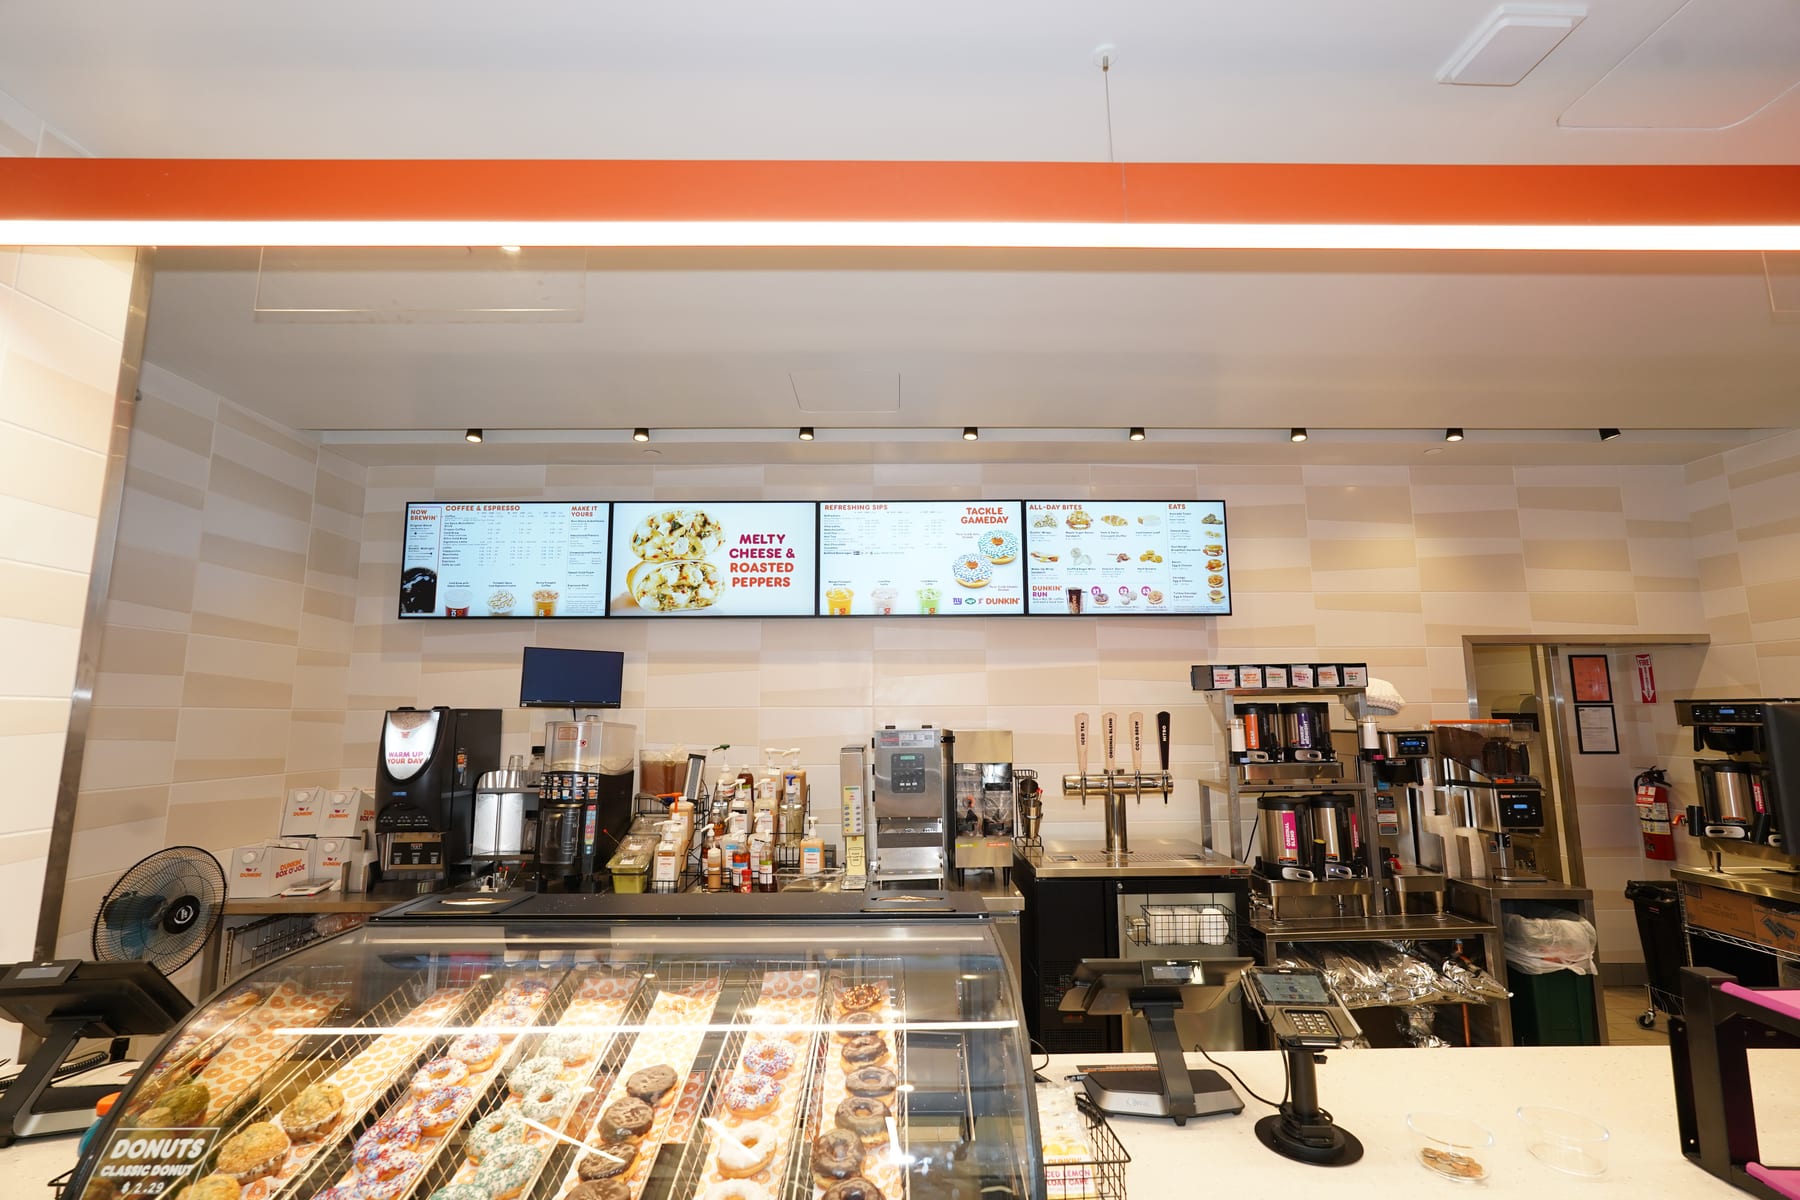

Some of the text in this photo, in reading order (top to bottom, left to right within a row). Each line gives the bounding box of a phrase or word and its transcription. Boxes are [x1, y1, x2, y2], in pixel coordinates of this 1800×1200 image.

[966, 507, 1003, 515] TACKLE
[960, 516, 1009, 524] GAMEDAY
[739, 534, 786, 544] MELTY
[728, 548, 795, 558] CHEESE &
[730, 562, 794, 573] ROASTED
[732, 576, 791, 588] PEPPERS
[276, 870, 288, 878] BOX
[110, 1138, 206, 1159] DONUTS
[100, 1164, 194, 1177] CLASSIC DONUT
[134, 1182, 165, 1195] 2.29
